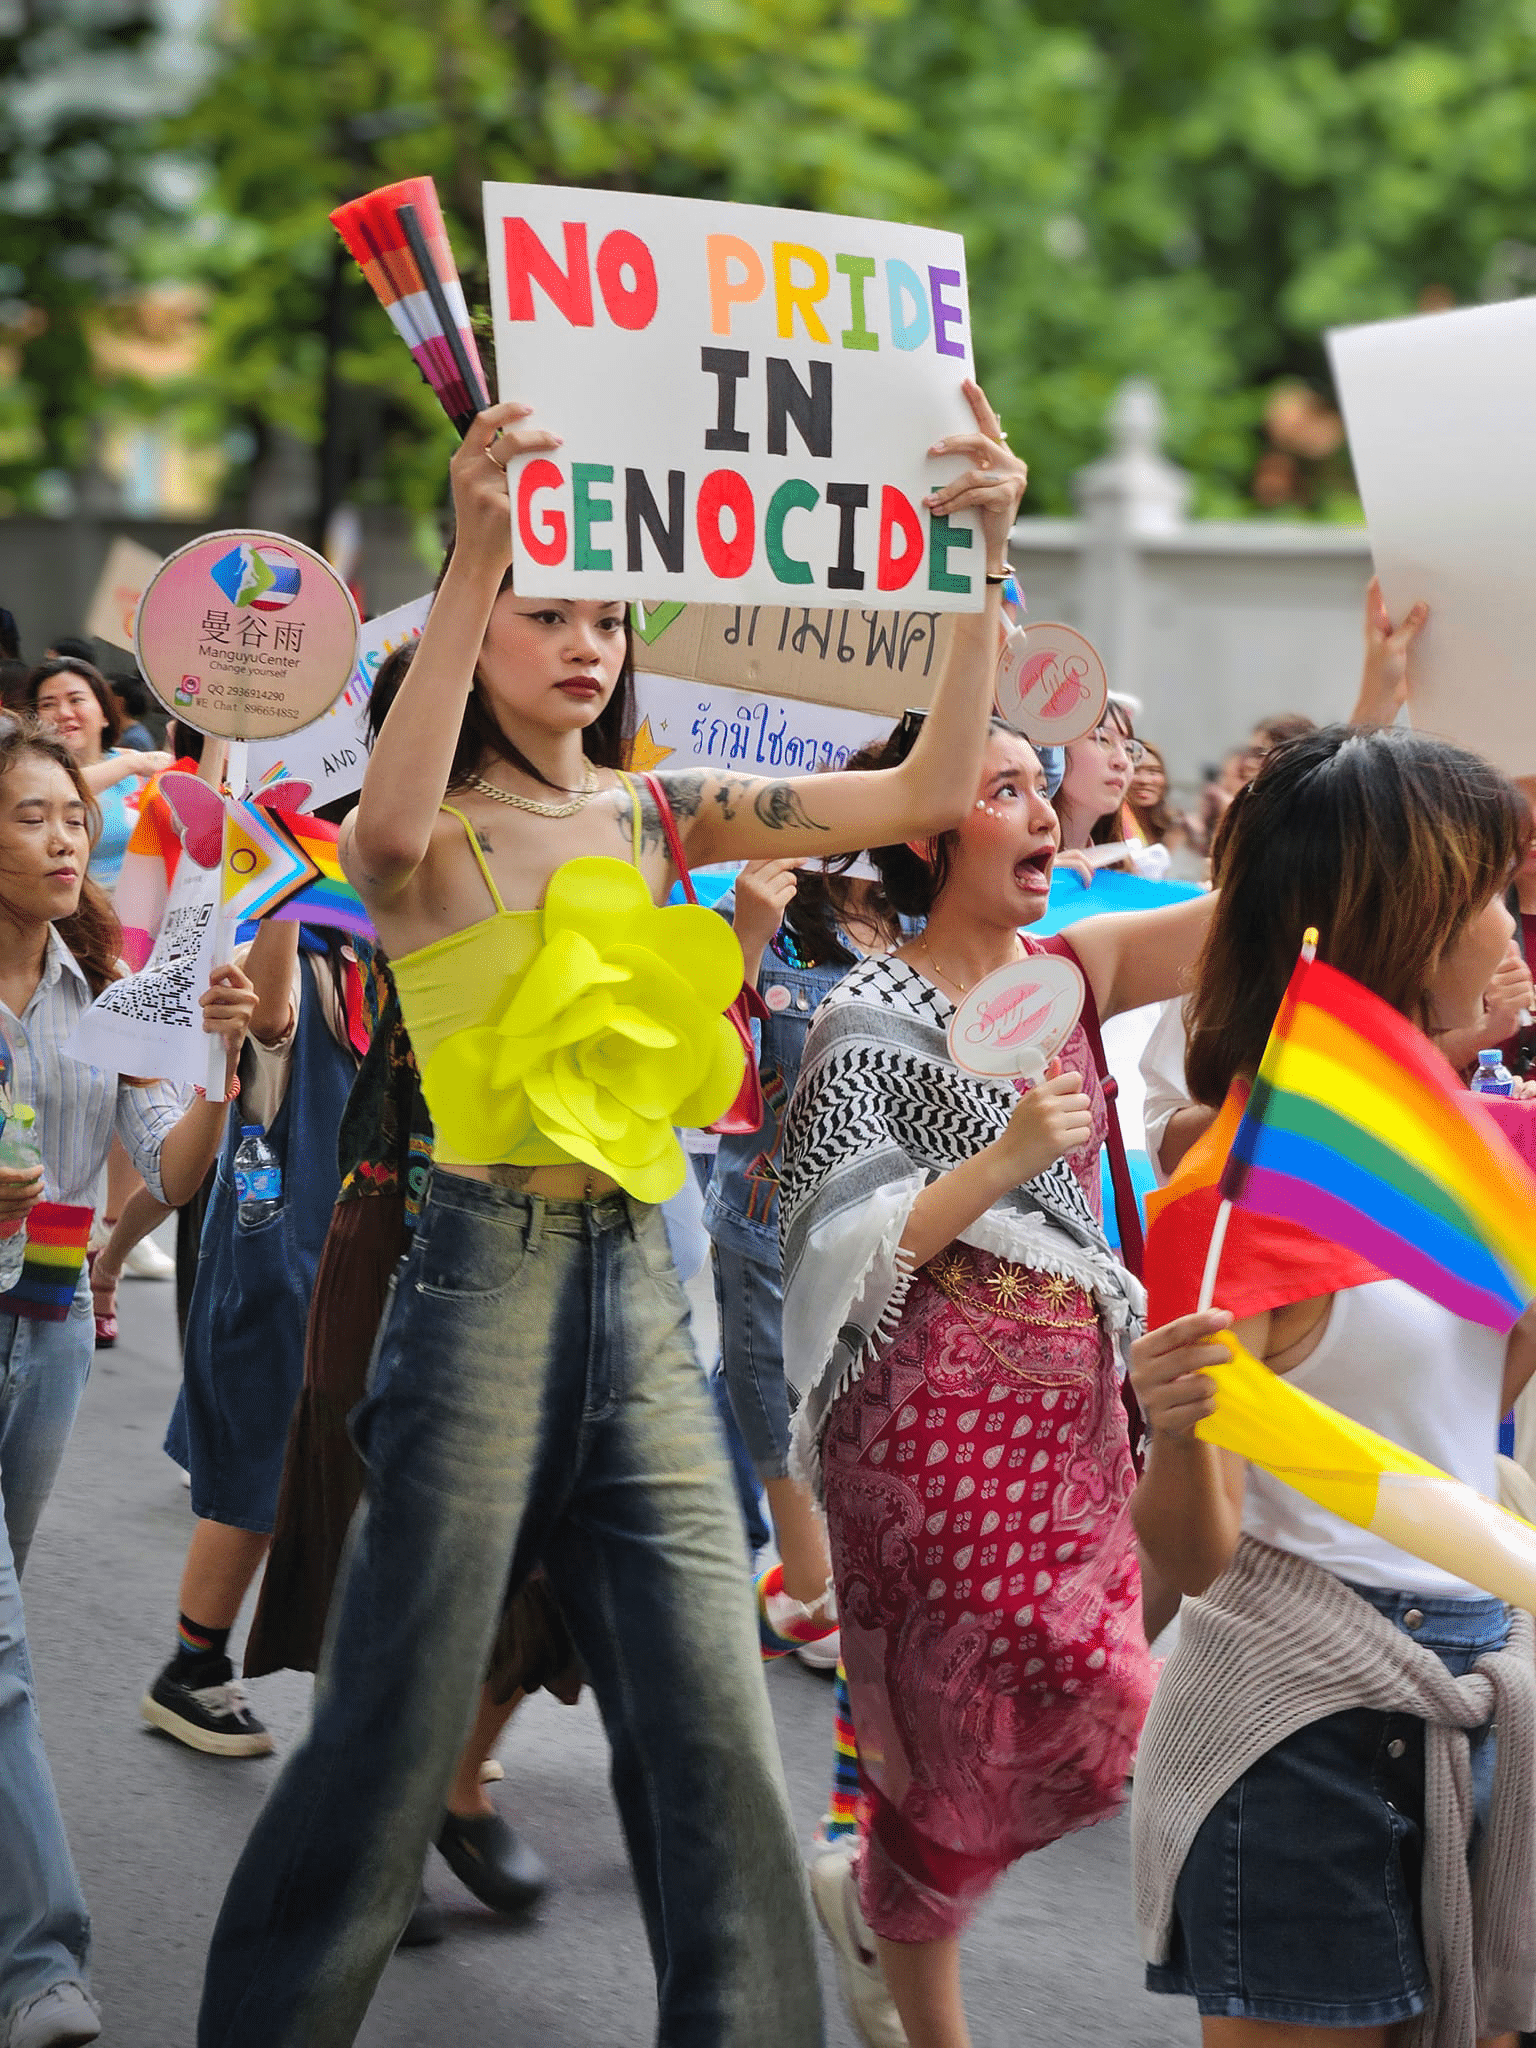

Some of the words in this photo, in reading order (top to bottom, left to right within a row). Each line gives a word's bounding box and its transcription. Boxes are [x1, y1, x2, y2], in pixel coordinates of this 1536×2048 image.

[502, 216, 659, 330] NO
[705, 233, 966, 359] PRIDE
[700, 346, 833, 458] IN
[517, 459, 974, 594] GENOCIDE
[198, 609, 306, 654] 曼谷雨
[198, 645, 301, 668] ManguyuCenter
[209, 661, 246, 675] Change
[248, 666, 288, 678] yourself
[207, 684, 224, 697] QQ
[227, 686, 285, 701] 2936914290
[213, 699, 238, 712] Chat
[322, 749, 357, 777] AND
